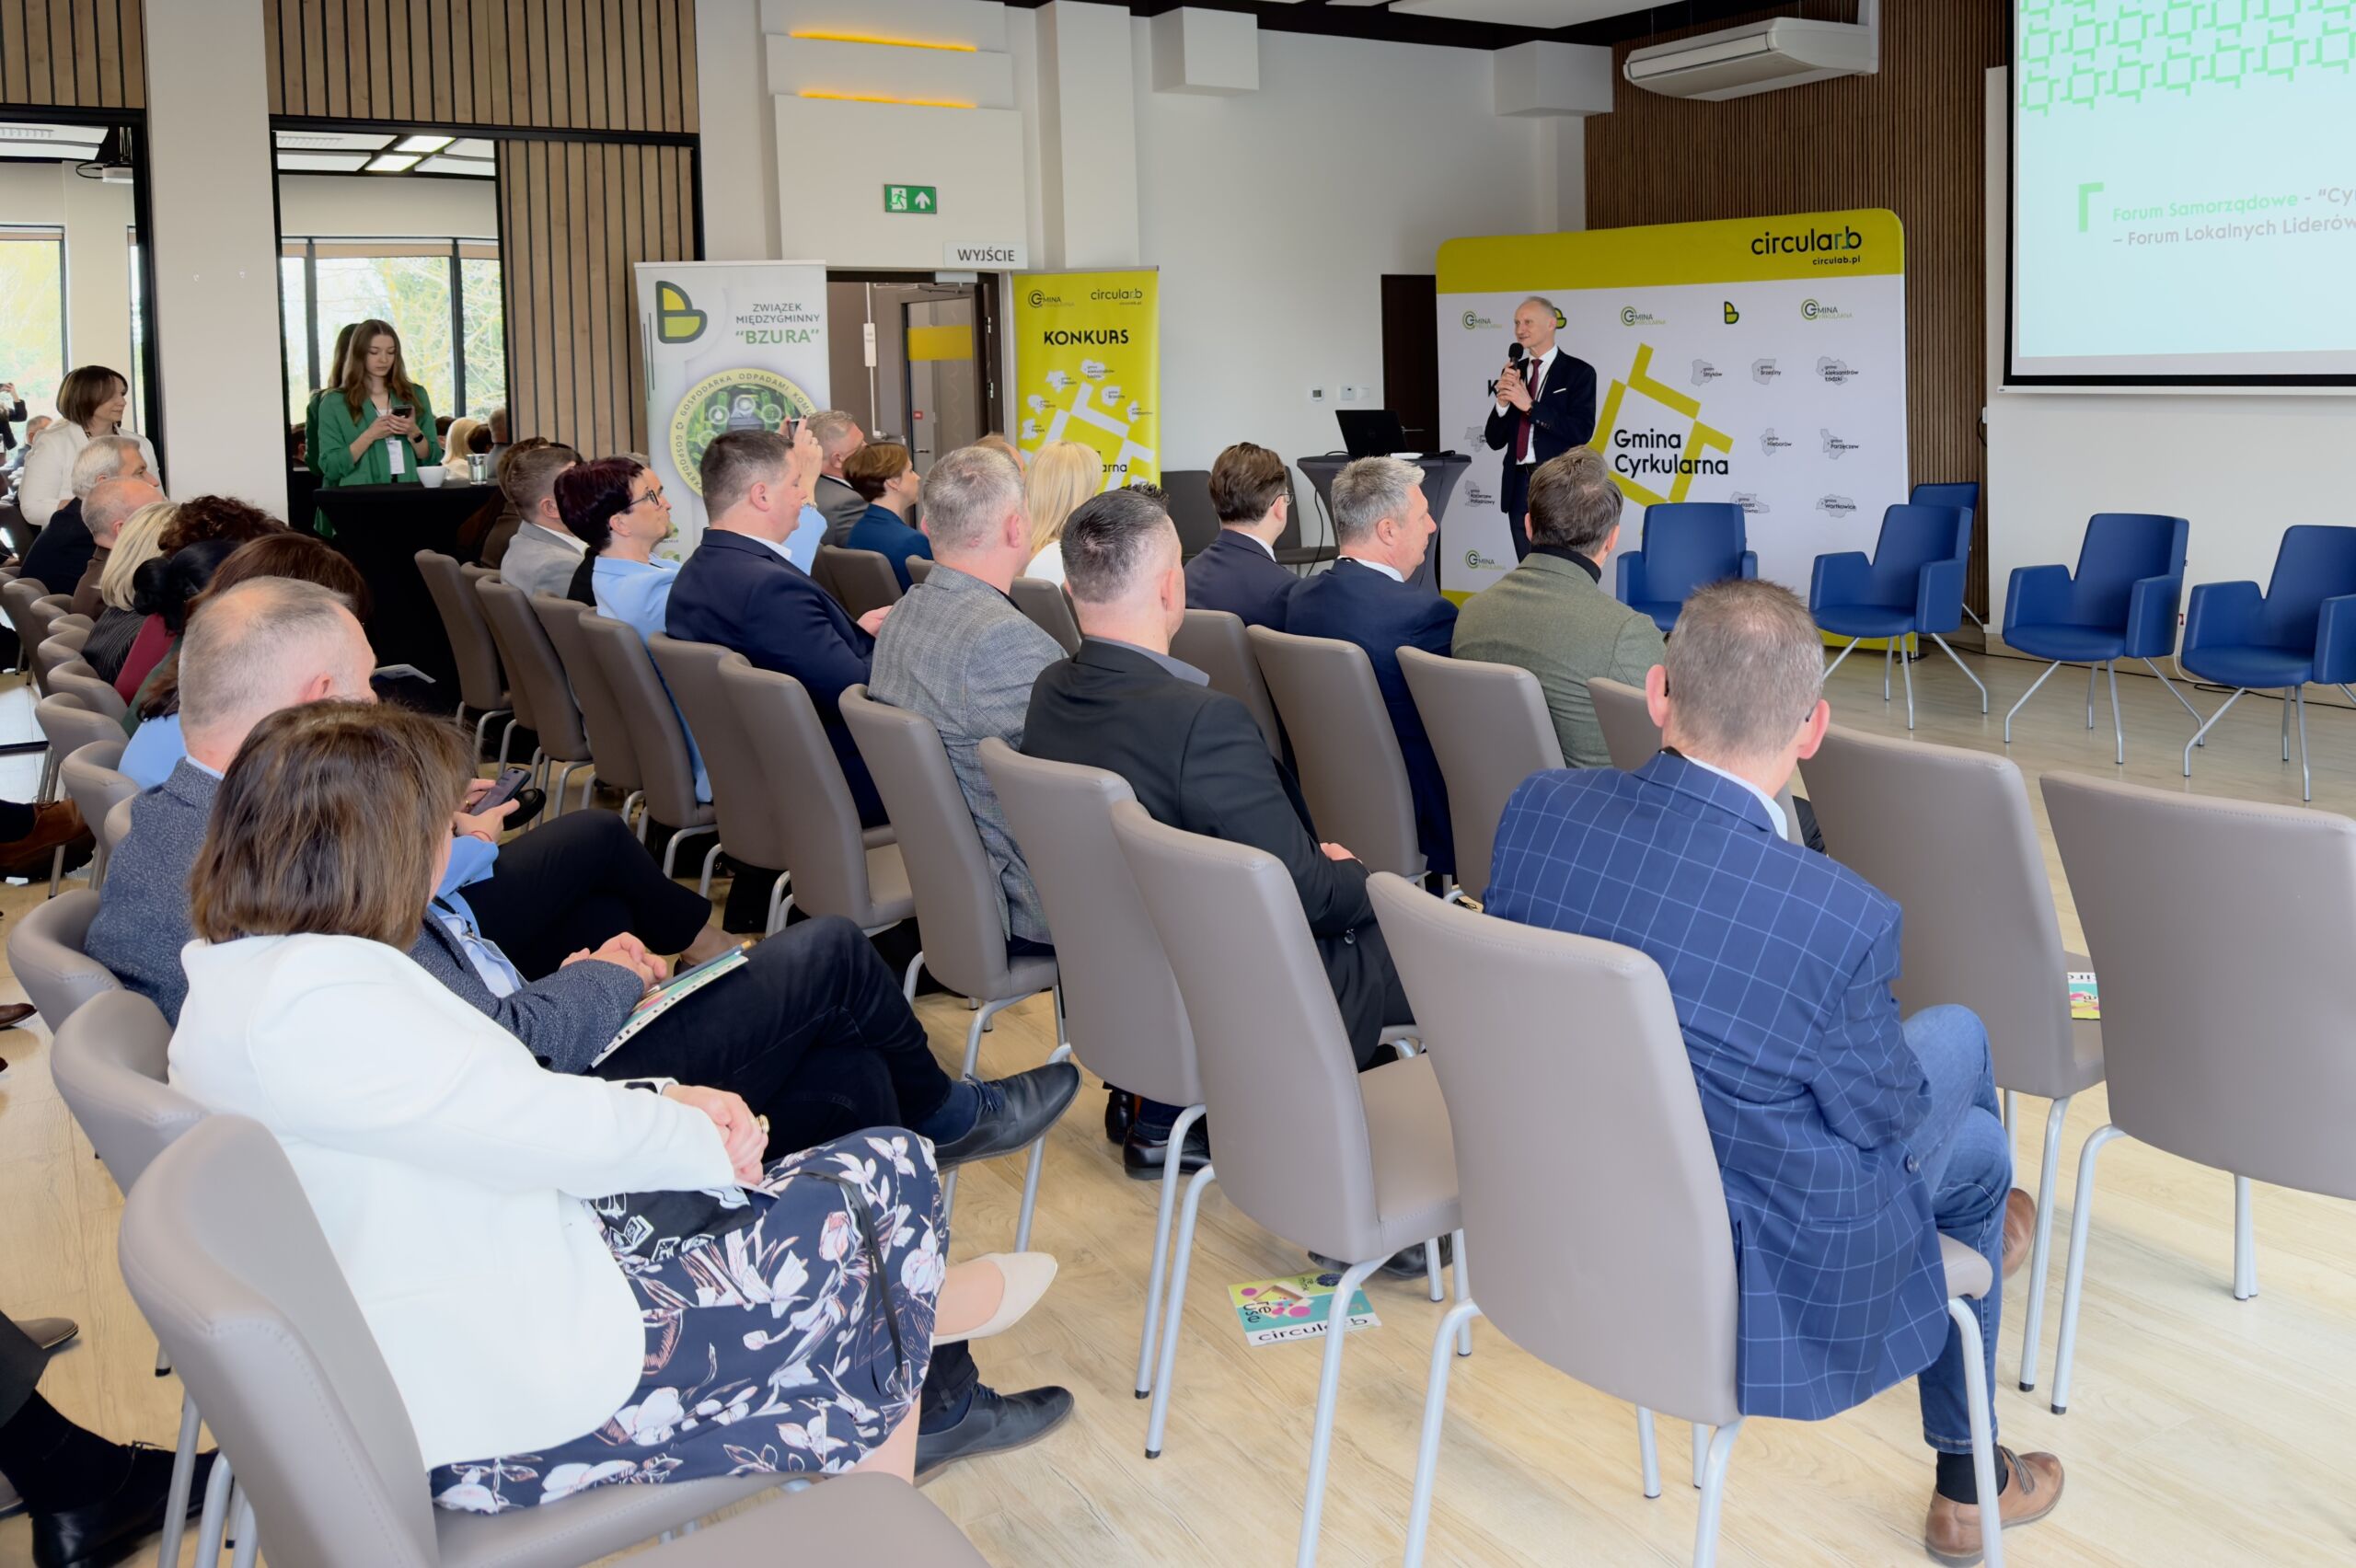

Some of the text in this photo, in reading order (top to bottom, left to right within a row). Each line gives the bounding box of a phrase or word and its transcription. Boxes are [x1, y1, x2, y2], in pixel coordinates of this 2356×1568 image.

[2112, 203, 2163, 222] Forum
[2168, 192, 2298, 218] Samorządowe
[2128, 230, 2179, 246] Forum
[2185, 219, 2277, 242] Lokalnych
[957, 247, 1015, 262] WYJŚCIE
[1812, 256, 1861, 265] circulab.pl
[753, 303, 803, 314] ZWIĄZEK
[736, 314, 820, 326] MIĘDZYGMINNY
[1044, 329, 1129, 345] KONKURS
[680, 375, 733, 417] GOSPODARKA
[739, 373, 790, 391] ODPADAMI
[1614, 428, 1681, 449] Gmina
[676, 434, 702, 490] GOSPODARK
[1615, 453, 1729, 478] Cyrkularna
